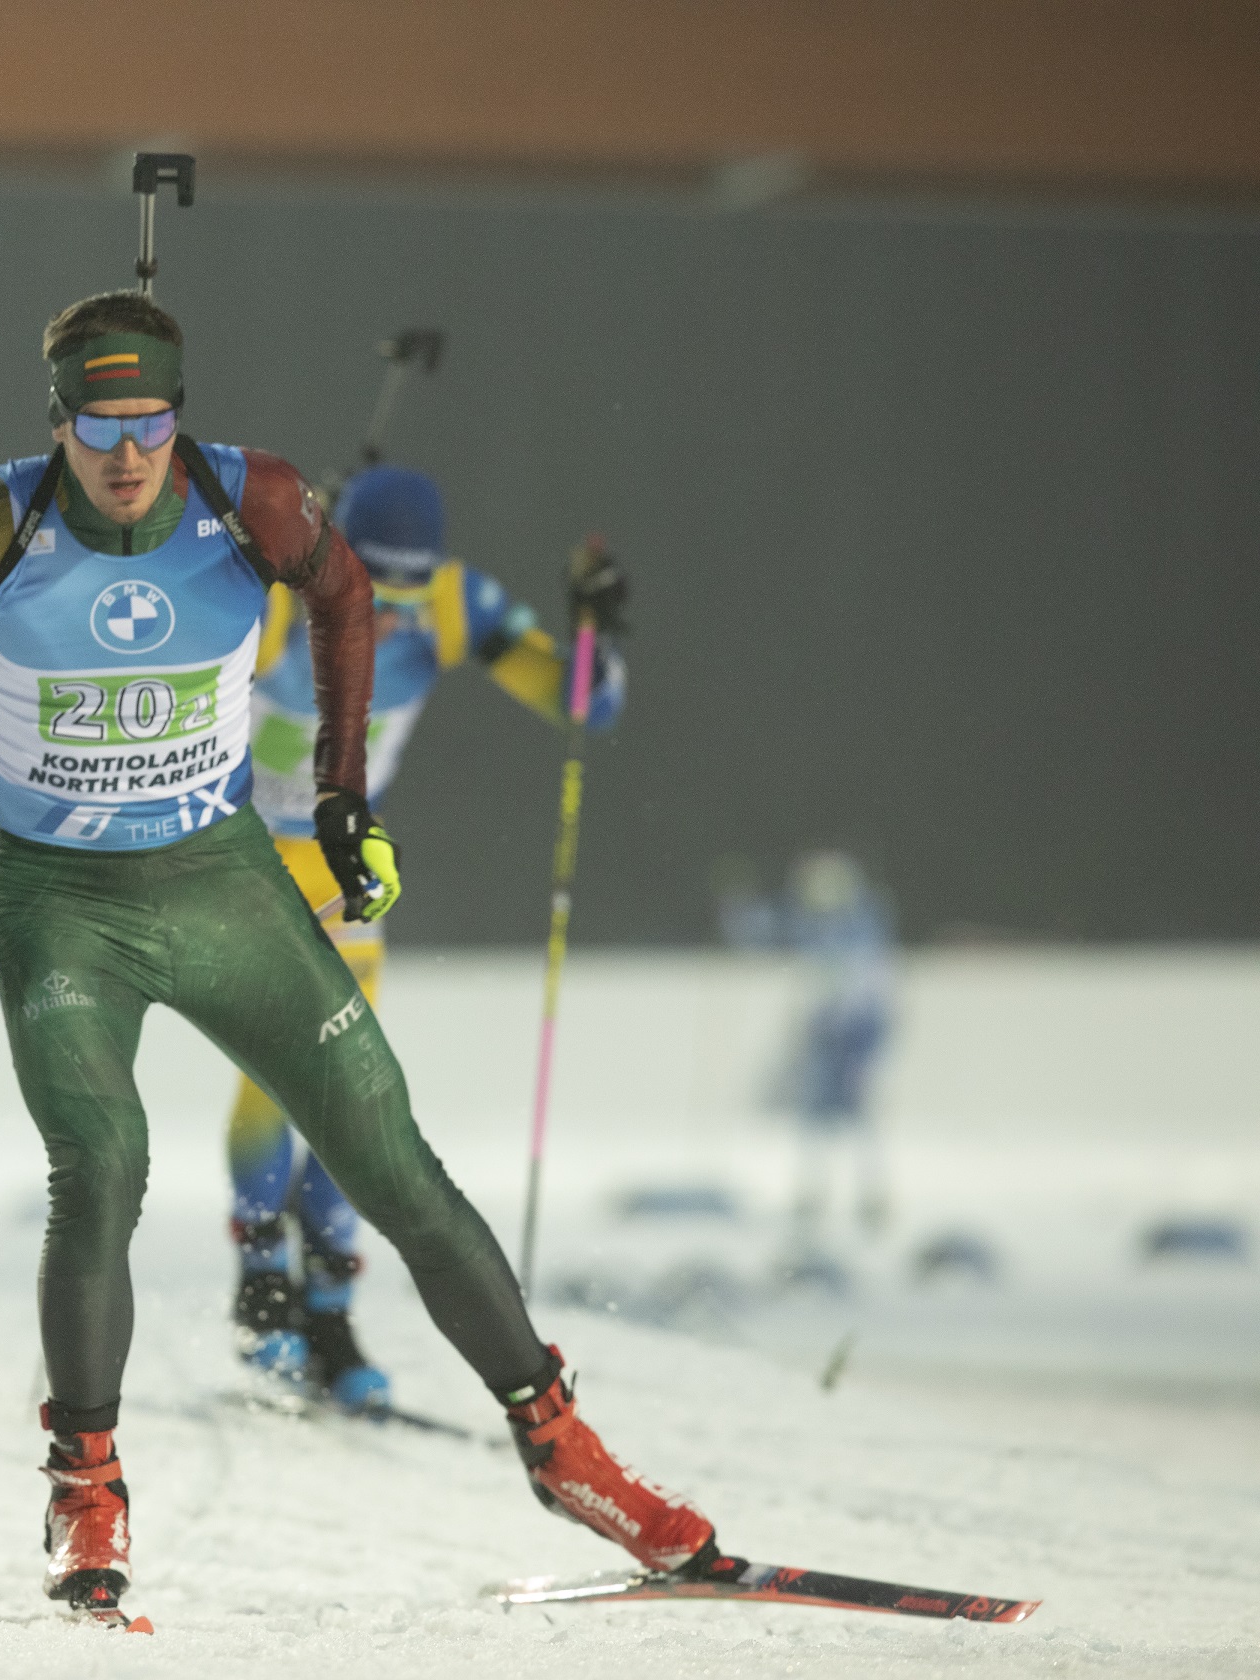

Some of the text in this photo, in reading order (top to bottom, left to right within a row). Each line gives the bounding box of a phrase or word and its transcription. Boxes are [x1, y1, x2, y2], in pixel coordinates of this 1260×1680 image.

[101, 583, 161, 607] BMW
[28, 750, 230, 794] NORTH KARELIA
[42, 735, 217, 774] KONTIOLAHTI
[124, 816, 177, 842] THE
[558, 1480, 642, 1538] alpina
